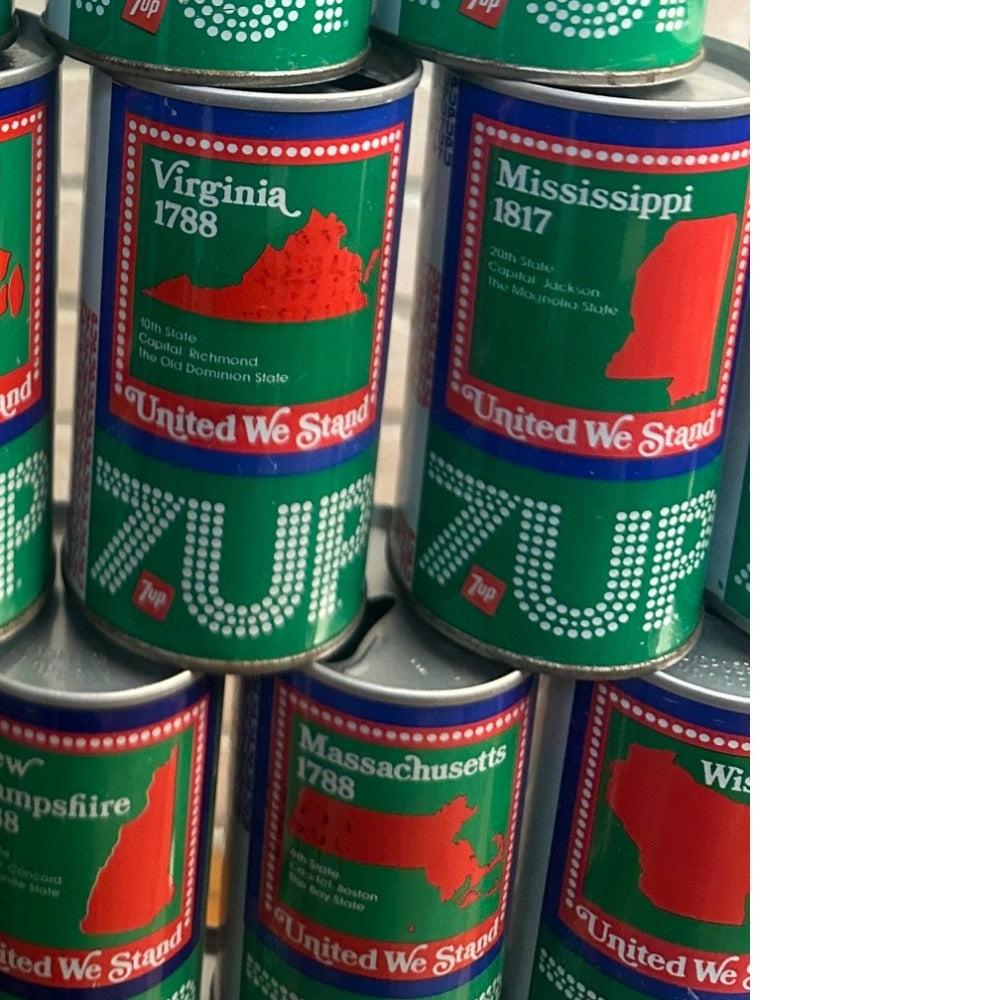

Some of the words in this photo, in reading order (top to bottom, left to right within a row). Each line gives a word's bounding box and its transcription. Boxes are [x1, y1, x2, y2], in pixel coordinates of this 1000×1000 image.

[151, 158, 301, 217] Virginia
[495, 157, 694, 220] Mississippi
[154, 200, 218, 238] 1788
[493, 197, 553, 234] 1817
[521, 256, 554, 273] State
[512, 285, 578, 310] Magnolia
[582, 302, 619, 316] State
[543, 278, 600, 297] Jackson
[165, 323, 197, 344] State
[160, 354, 183, 371] Old
[186, 362, 251, 383] Dominion
[255, 372, 289, 384] State
[189, 348, 258, 368] Richmond
[125, 385, 237, 441] United
[243, 406, 290, 444] We
[296, 397, 368, 449] Stand
[461, 384, 575, 444] United
[585, 415, 634, 450] We
[638, 411, 715, 457] Stand
[140, 580, 167, 609] 7up
[469, 574, 498, 600] 7up
[299, 723, 507, 782] Massachusetts
[296, 756, 355, 800] 1788
[58, 949, 102, 981] We
[108, 922, 183, 983] Stand
[274, 908, 377, 971] United
[383, 944, 428, 973] We
[432, 917, 499, 975] Stand
[576, 904, 686, 978] United
[694, 955, 740, 984] We
